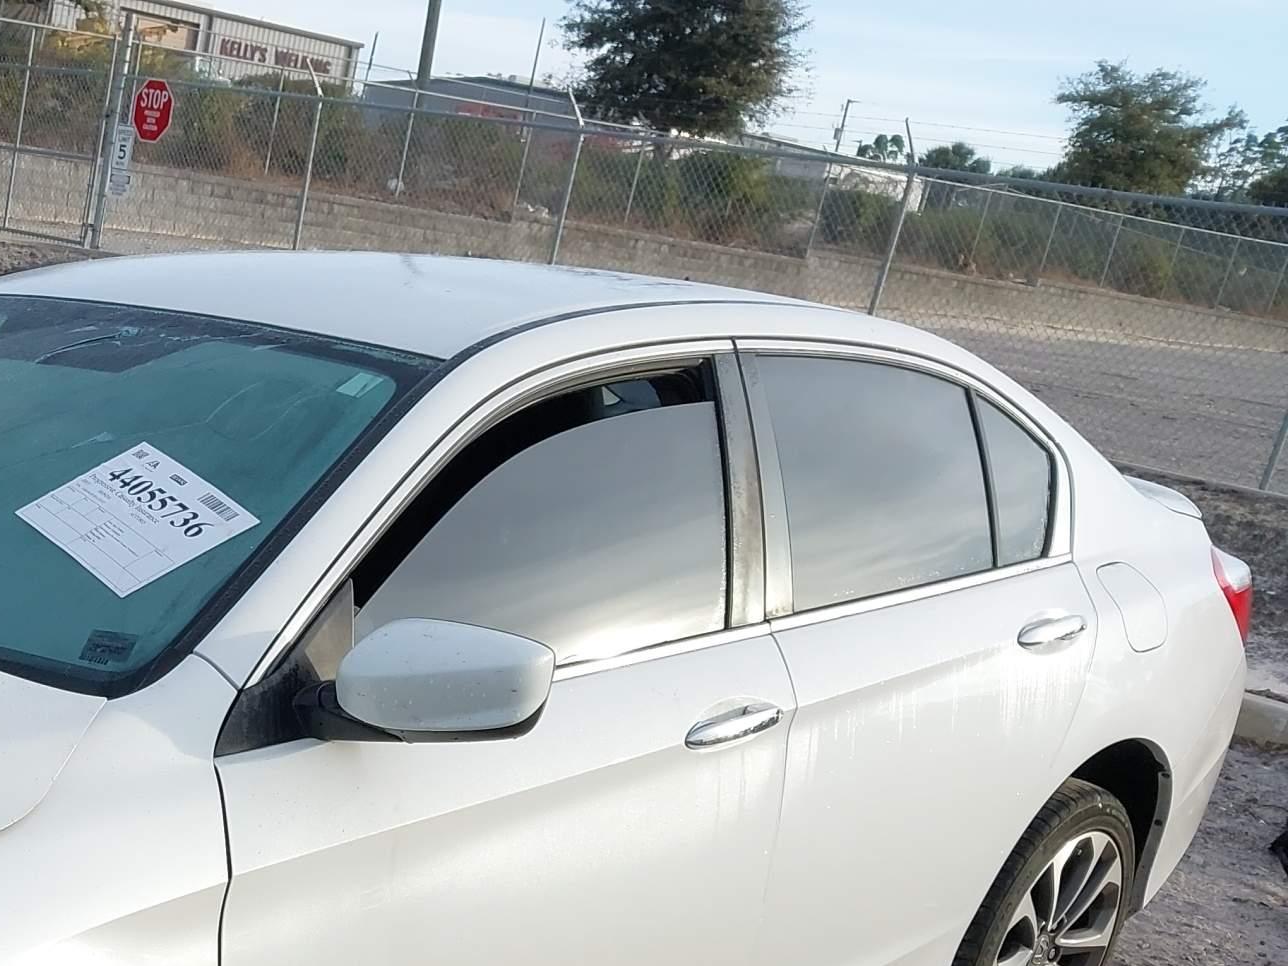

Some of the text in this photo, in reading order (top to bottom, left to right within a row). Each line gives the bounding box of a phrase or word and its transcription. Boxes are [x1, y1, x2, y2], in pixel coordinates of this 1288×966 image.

[219, 38, 268, 63] KELLY'S
[140, 88, 169, 110] STOP
[117, 144, 127, 160] 5
[108, 468, 214, 537] 44055736
